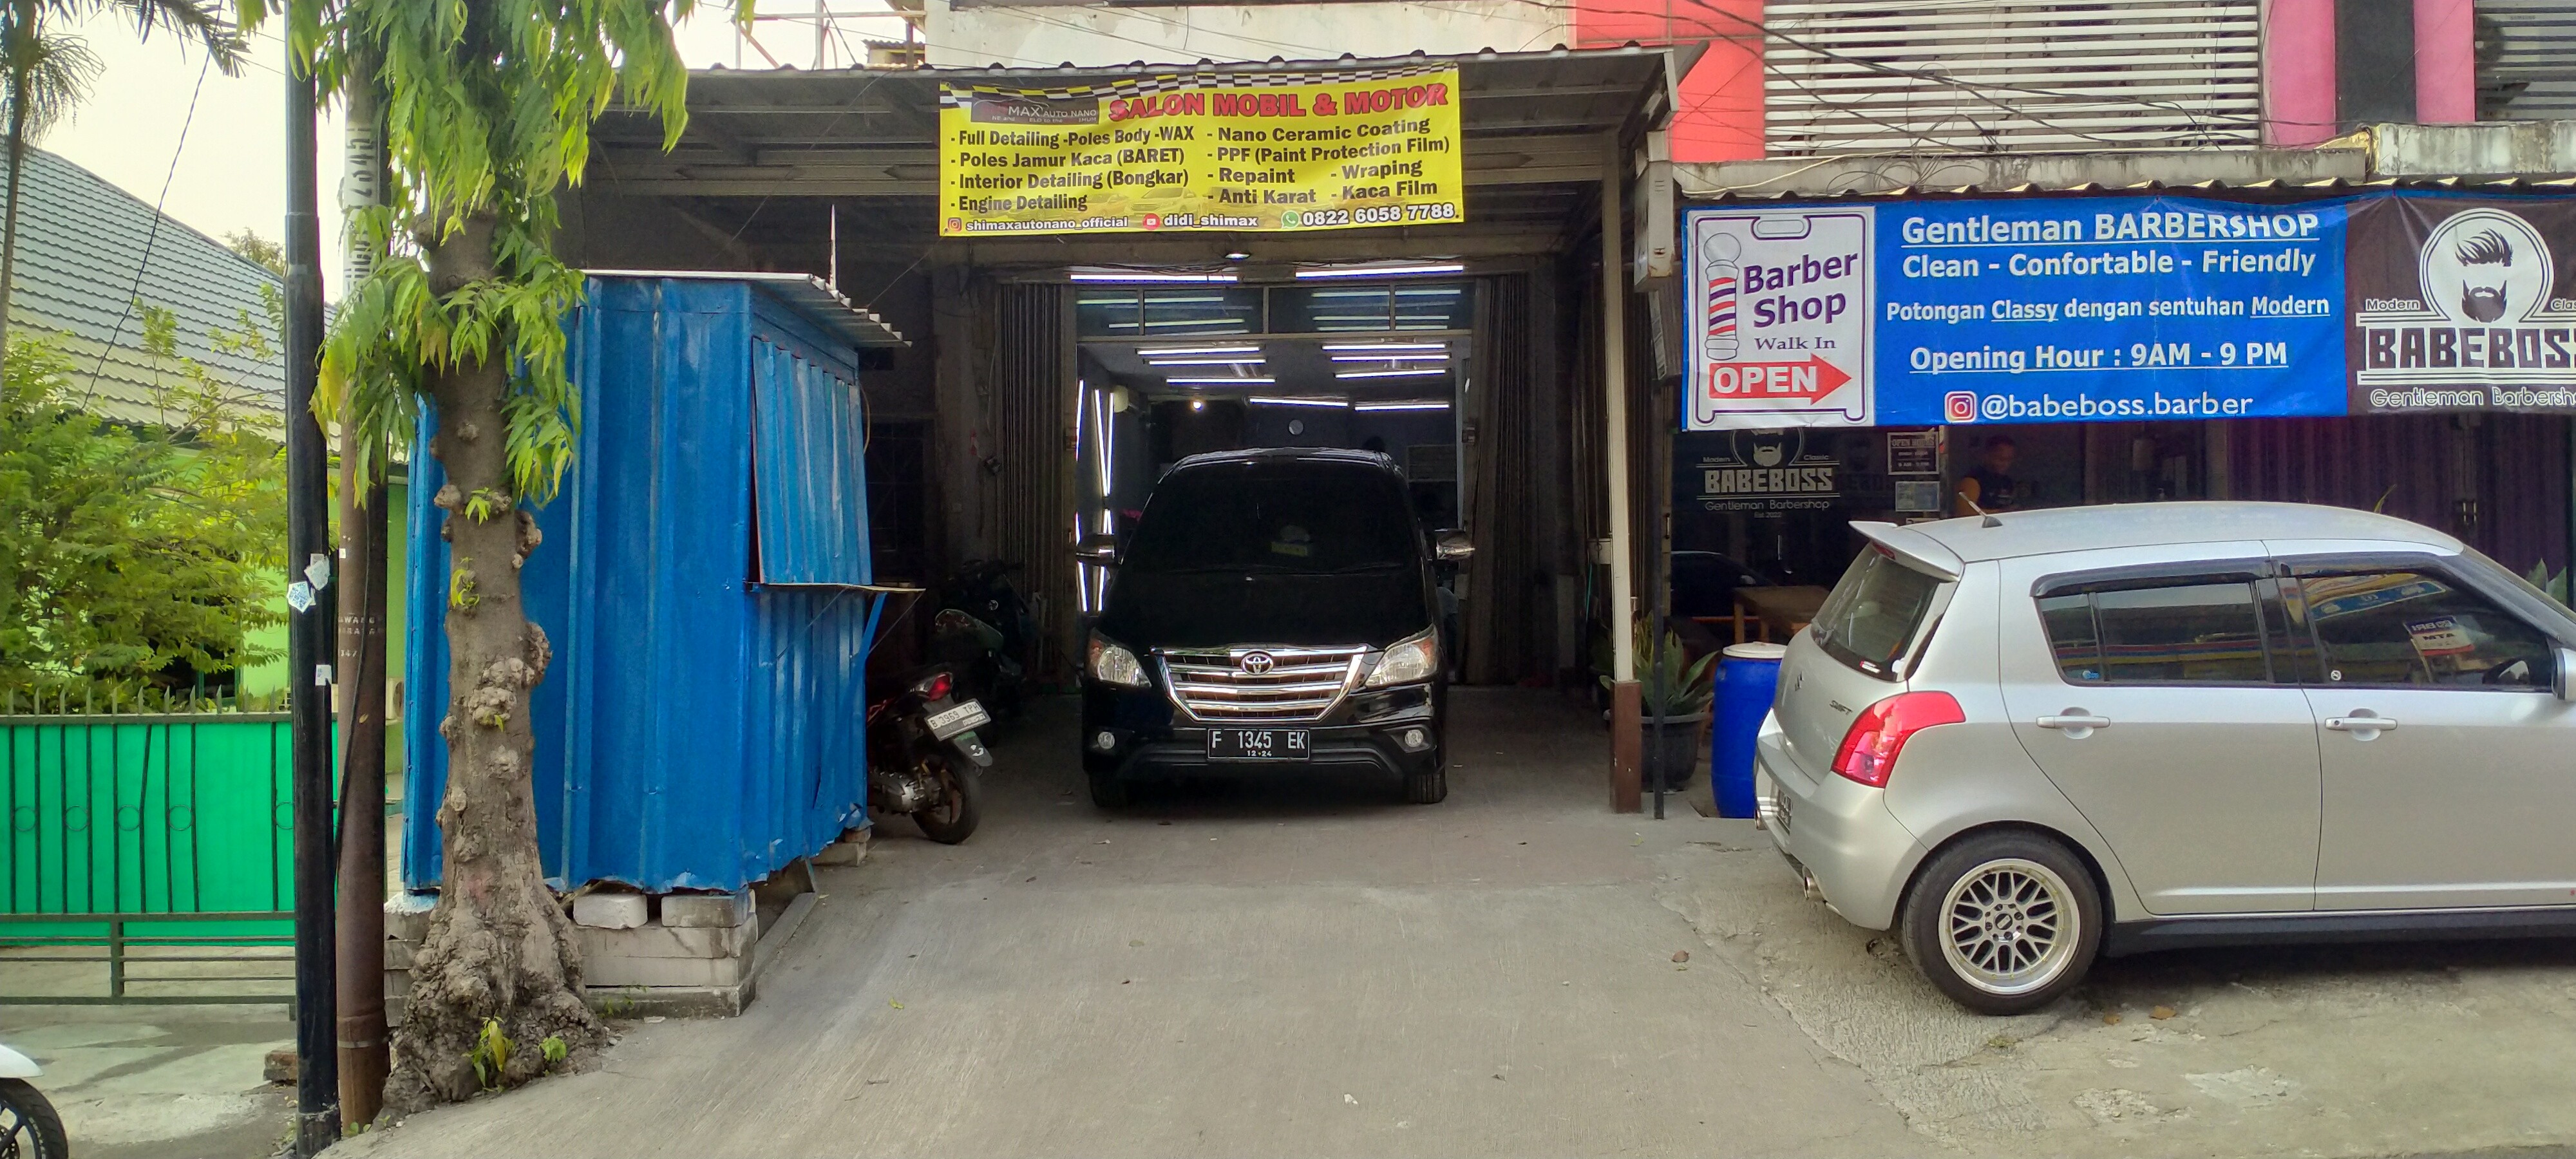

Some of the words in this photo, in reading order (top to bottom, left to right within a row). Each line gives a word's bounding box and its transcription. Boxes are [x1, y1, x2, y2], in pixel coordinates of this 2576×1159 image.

[1109, 93, 1205, 122] SALON
[1213, 93, 1307, 117] MOBIL
[1312, 93, 1337, 116] &
[1345, 83, 1448, 115] MOTOR
[960, 131, 985, 146] Full
[990, 131, 1059, 149] Detailing
[1115, 129, 1150, 145] Body
[1218, 127, 1267, 142] Nano
[1273, 124, 1352, 142] Ceramic
[1357, 118, 1431, 138] Coating
[960, 153, 1007, 167] Poles
[1012, 153, 1066, 168] Jamur
[1071, 152, 1112, 167] Kaca
[1117, 147, 1184, 167] (BARET)
[1218, 147, 1251, 162] PPF
[1255, 147, 1307, 165] (Paint
[1312, 141, 1401, 162] Protection
[1406, 137, 1450, 154] Film)
[960, 173, 1023, 189] Interior
[1028, 171, 1103, 189] Detailing
[1107, 169, 1189, 189] (Bongkar)
[1219, 167, 1295, 186] Repaint
[1341, 160, 1423, 180] Wraping
[1219, 189, 1258, 204] Anti
[1264, 189, 1316, 204] Karat
[1342, 184, 1390, 200] Kaca
[1396, 180, 1437, 196] Film
[960, 196, 1012, 214] Engine
[1016, 194, 1088, 211] Detailing
[966, 217, 1128, 232] shimaxautonano_official
[1163, 212, 1258, 228] didi_shimax
[1302, 211, 1349, 227] 0822
[1354, 206, 1401, 224] 6058
[1901, 215, 2083, 244] Gentleman
[2094, 212, 2320, 241] BARBERSHOP
[1743, 252, 1858, 295] Barber
[1902, 254, 1979, 278] Clean
[2008, 250, 2173, 276] Confortable
[2202, 248, 2316, 277] Friendly
[1753, 292, 1846, 328] Shop
[1886, 301, 1985, 325] Potongan
[1991, 300, 2059, 323] Classy
[2064, 298, 2142, 321] dengan
[2148, 297, 2244, 317] sentuhan
[2250, 295, 2330, 316] Modern
[2365, 299, 2420, 311] Modern
[1754, 337, 1808, 350] Walk
[1814, 336, 1836, 349] In
[2368, 327, 2576, 370] BABEBOS
[1909, 345, 2025, 373] Opening
[2035, 344, 2104, 368] Hour
[2131, 343, 2190, 367] 9AM
[2221, 343, 2236, 366] 9
[2246, 341, 2287, 366] PM
[1713, 366, 1818, 394] OPEN
[1982, 390, 2253, 420] @babeboss.barber
[2371, 388, 2484, 407] Gentleman
[2492, 386, 2576, 406] Barbersh
[1705, 467, 1833, 493] BABEBOSS
[1705, 502, 1764, 511] Gentleman
[1770, 499, 1830, 511] Barbershop
[930, 719, 938, 728] B
[938, 711, 960, 724] 3969
[1212, 731, 1222, 748] F
[1238, 731, 1273, 749] 1345
[1288, 731, 1306, 749] EK
